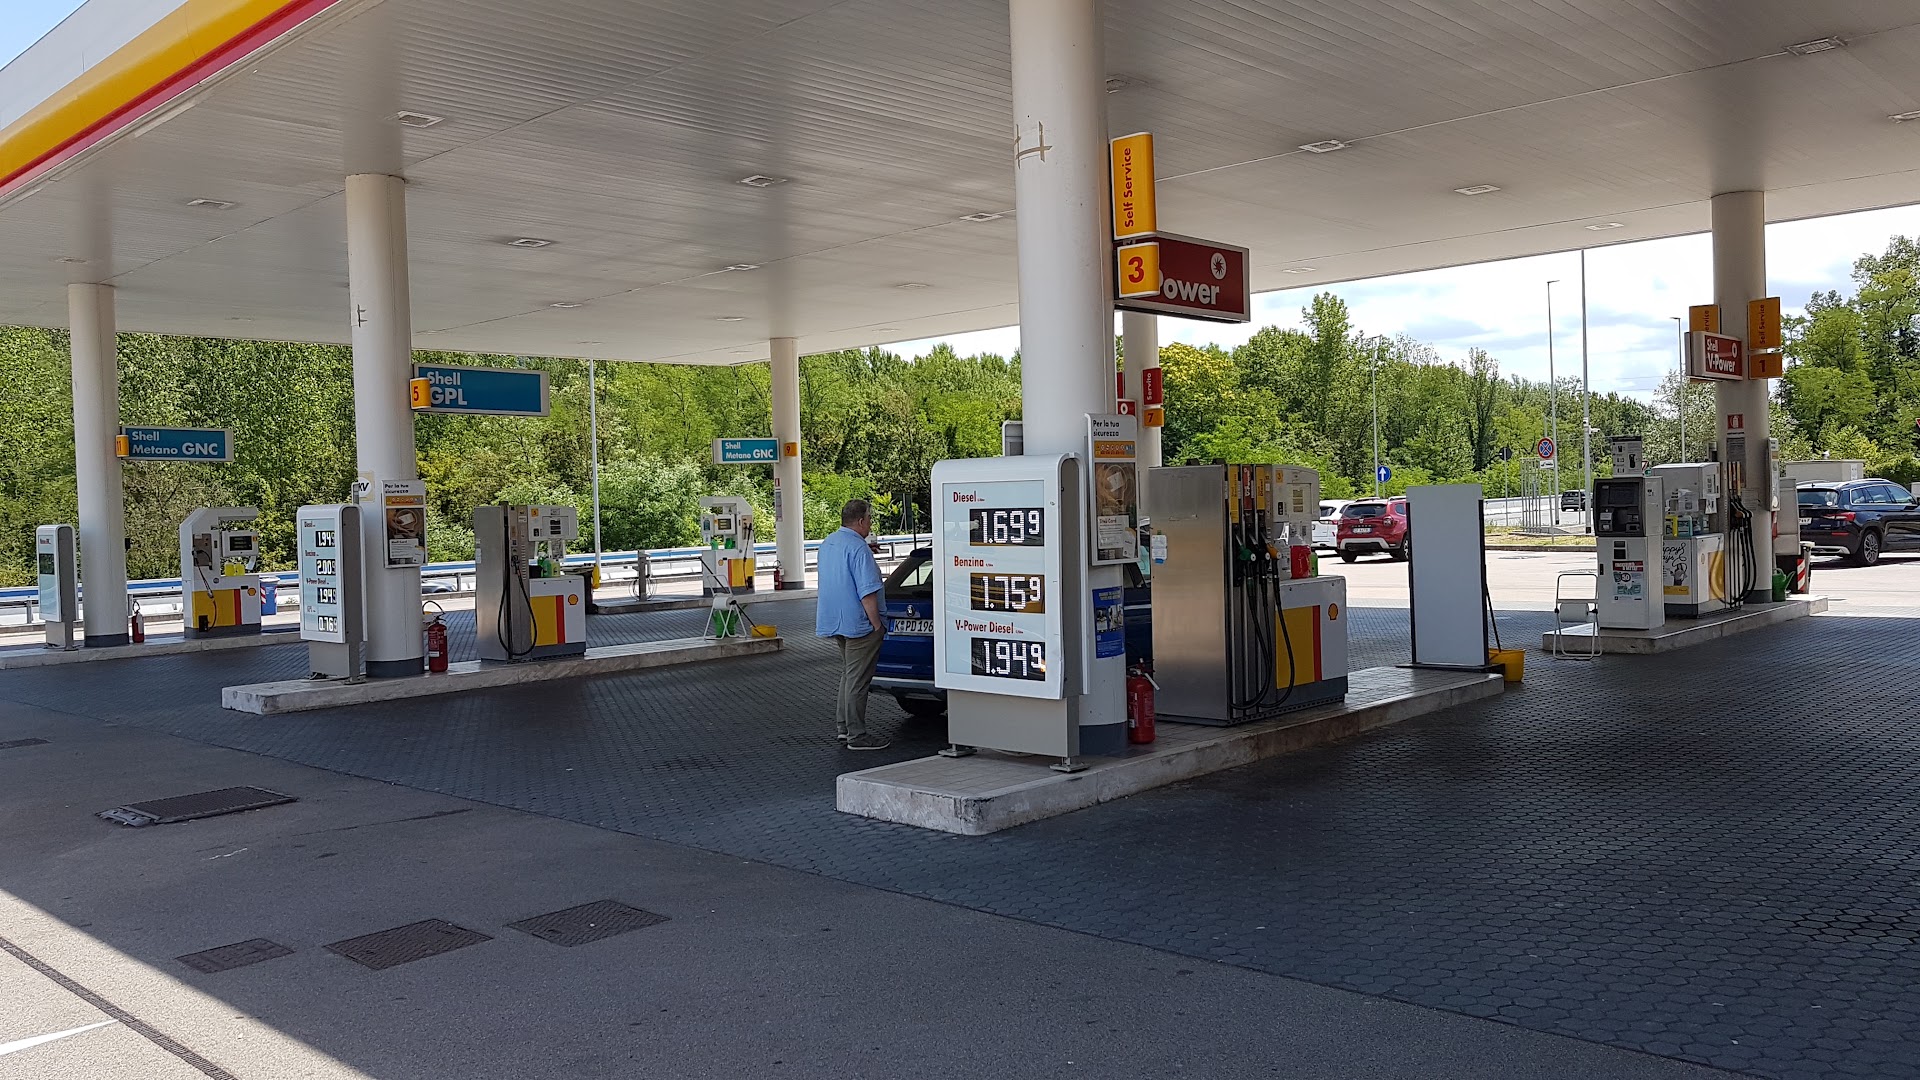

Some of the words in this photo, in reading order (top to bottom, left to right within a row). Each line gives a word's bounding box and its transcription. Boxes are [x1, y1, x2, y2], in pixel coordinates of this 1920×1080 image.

[1122, 147, 1133, 198] Service
[1123, 200, 1134, 228] Self
[1127, 256, 1145, 284] 3
[1707, 339, 1719, 352] Shell
[1707, 353, 1736, 373] V-Power
[1759, 360, 1766, 373] 1
[426, 371, 461, 386] Shell
[413, 386, 420, 402] 5
[430, 387, 468, 406] GPL
[1092, 420, 1102, 428] Per
[1103, 420, 1109, 428] la
[1147, 412, 1154, 423] 7
[131, 430, 160, 442] Shell
[1093, 429, 1120, 437] sicurezza
[132, 445, 178, 455] Metano
[181, 442, 218, 456] GNC
[725, 442, 742, 450] Shell
[786, 445, 791, 454] 9
[752, 449, 774, 459] GNC
[953, 490, 977, 503] Diesel
[981, 510, 1040, 544] 1.699
[954, 556, 984, 567] Benzina
[982, 576, 1041, 609] 1.759
[894, 620, 901, 631] K
[905, 620, 917, 631] PD
[955, 619, 987, 632] V-Power
[989, 622, 1014, 634] Diesel
[983, 641, 1042, 676] 1.949
